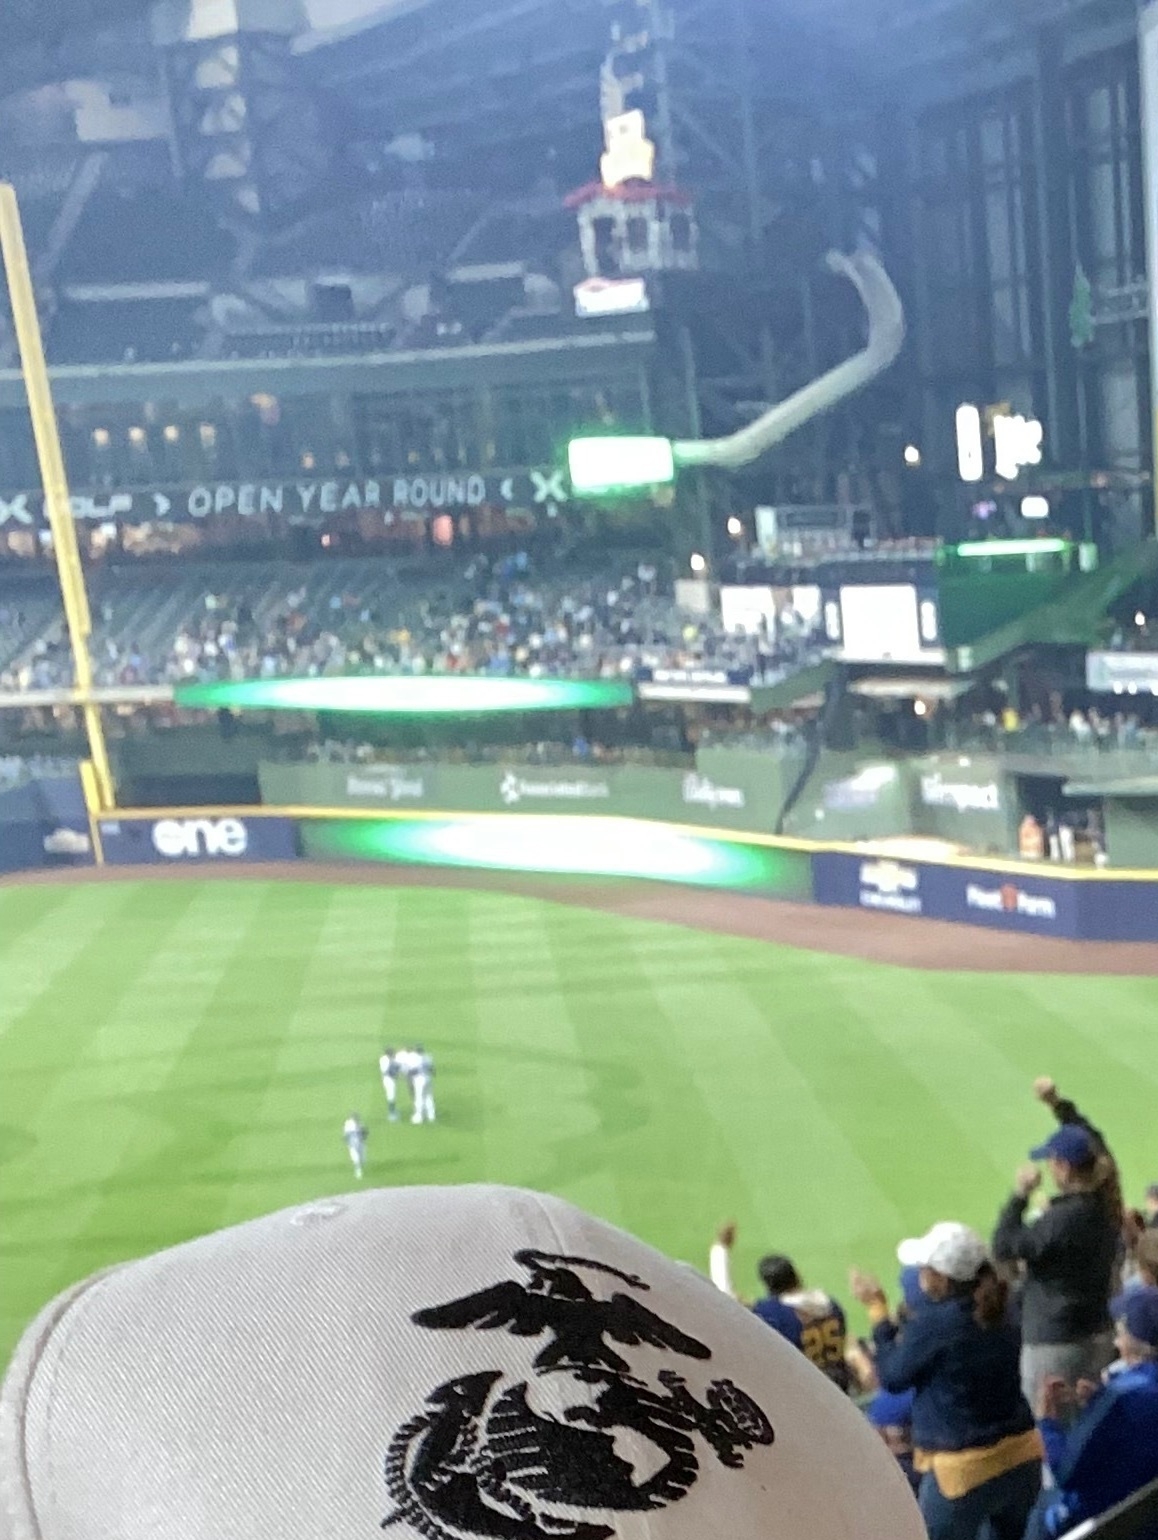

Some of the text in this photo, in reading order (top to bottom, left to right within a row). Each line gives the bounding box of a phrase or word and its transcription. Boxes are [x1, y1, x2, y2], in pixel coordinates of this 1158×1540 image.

[188, 482, 284, 518] OPEN
[297, 478, 380, 513] YEAR
[393, 473, 486, 507] ROUND
[152, 818, 248, 857] one
